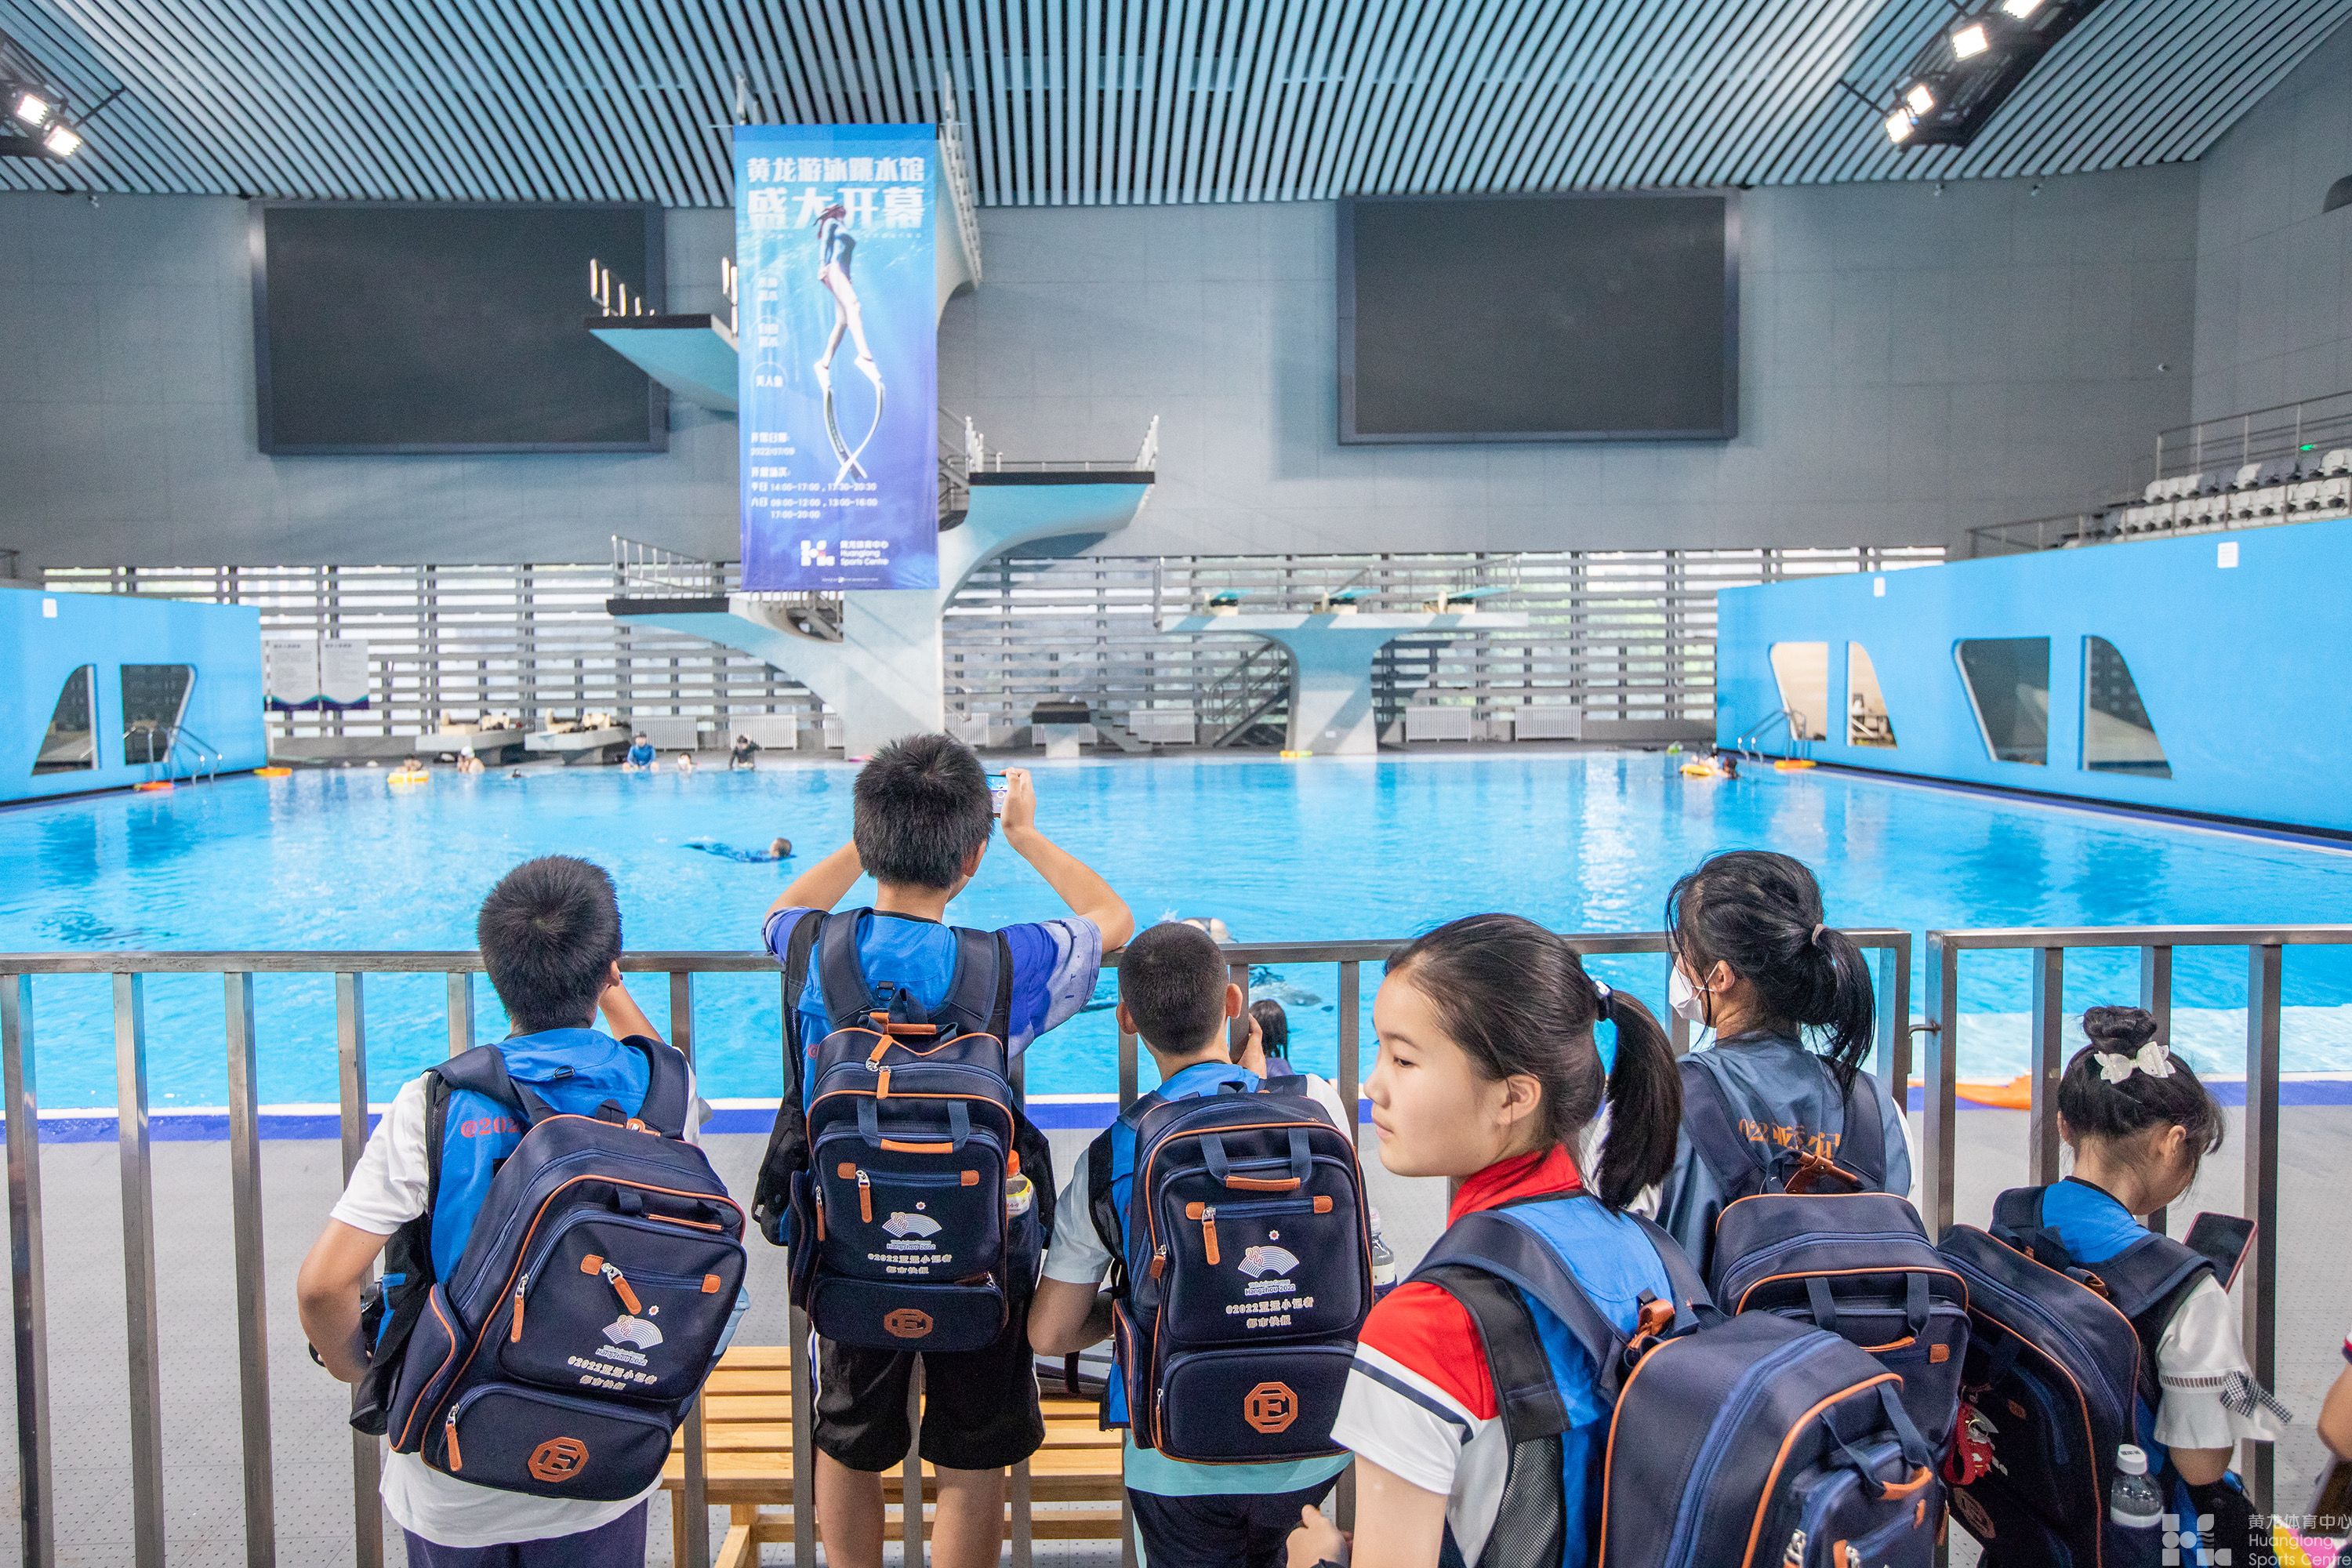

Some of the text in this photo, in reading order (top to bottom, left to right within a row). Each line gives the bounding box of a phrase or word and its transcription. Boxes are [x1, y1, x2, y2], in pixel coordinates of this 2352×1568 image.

[747, 157, 924, 182] 黄龙游泳跳水馆
[747, 187, 925, 229] 盛大开幕
[1245, 1283, 1296, 1295] Hangzhou 2022
[1247, 1315, 1292, 1329] 都市快报
[595, 1348, 630, 1362] Hangzhou
[629, 1356, 648, 1367] 2022
